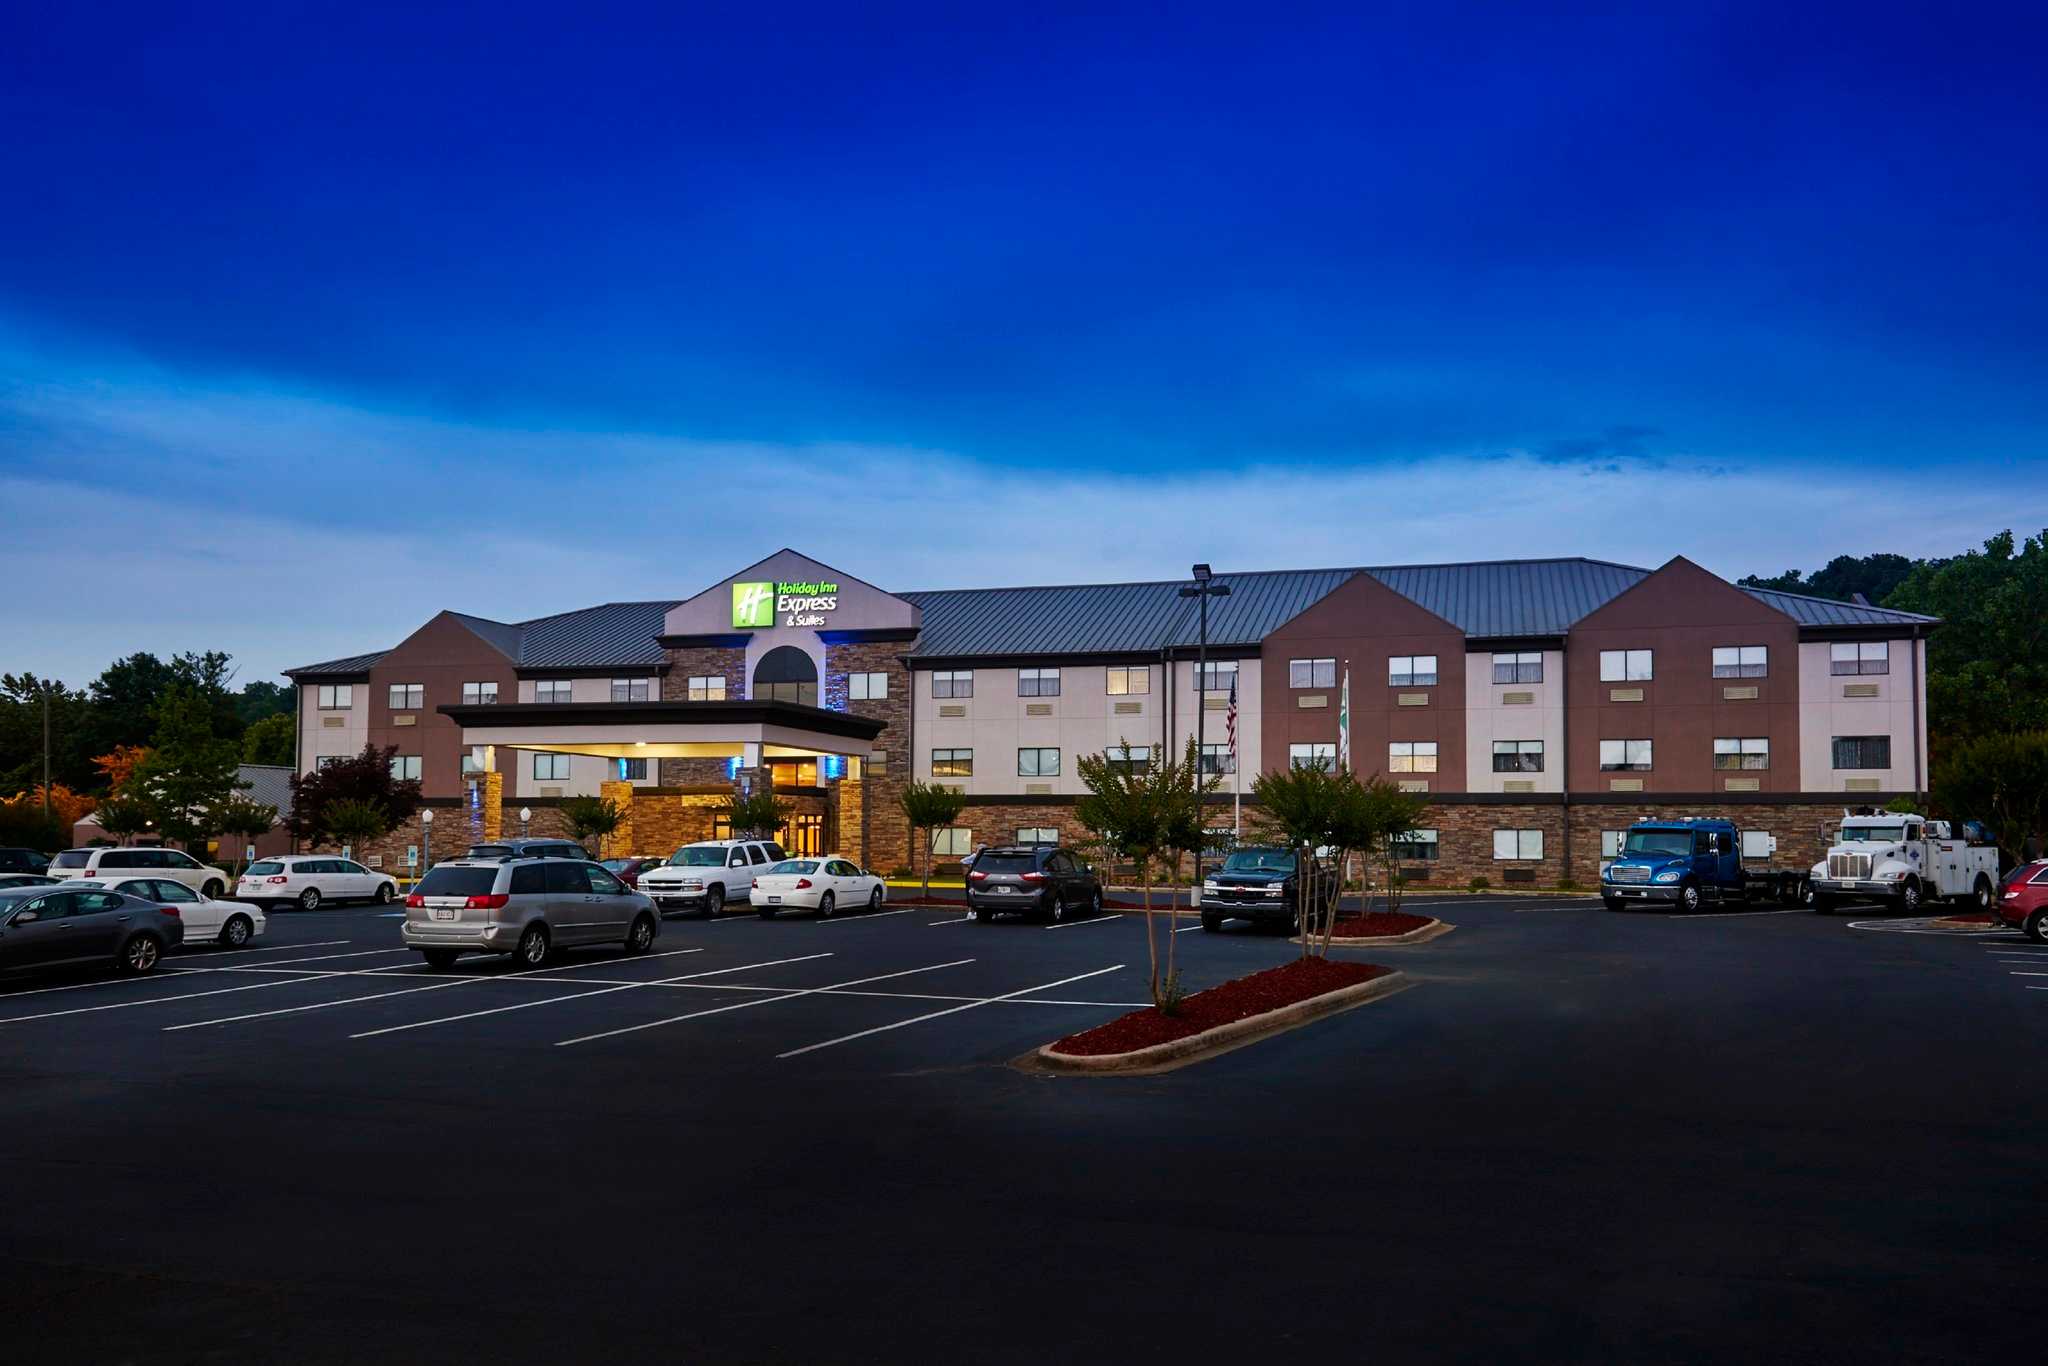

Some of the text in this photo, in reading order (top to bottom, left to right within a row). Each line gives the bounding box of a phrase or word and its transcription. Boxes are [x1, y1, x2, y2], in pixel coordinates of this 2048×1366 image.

[778, 581, 837, 596] Holiday Inn
[777, 594, 837, 615] Express
[787, 614, 825, 626] & Suites
